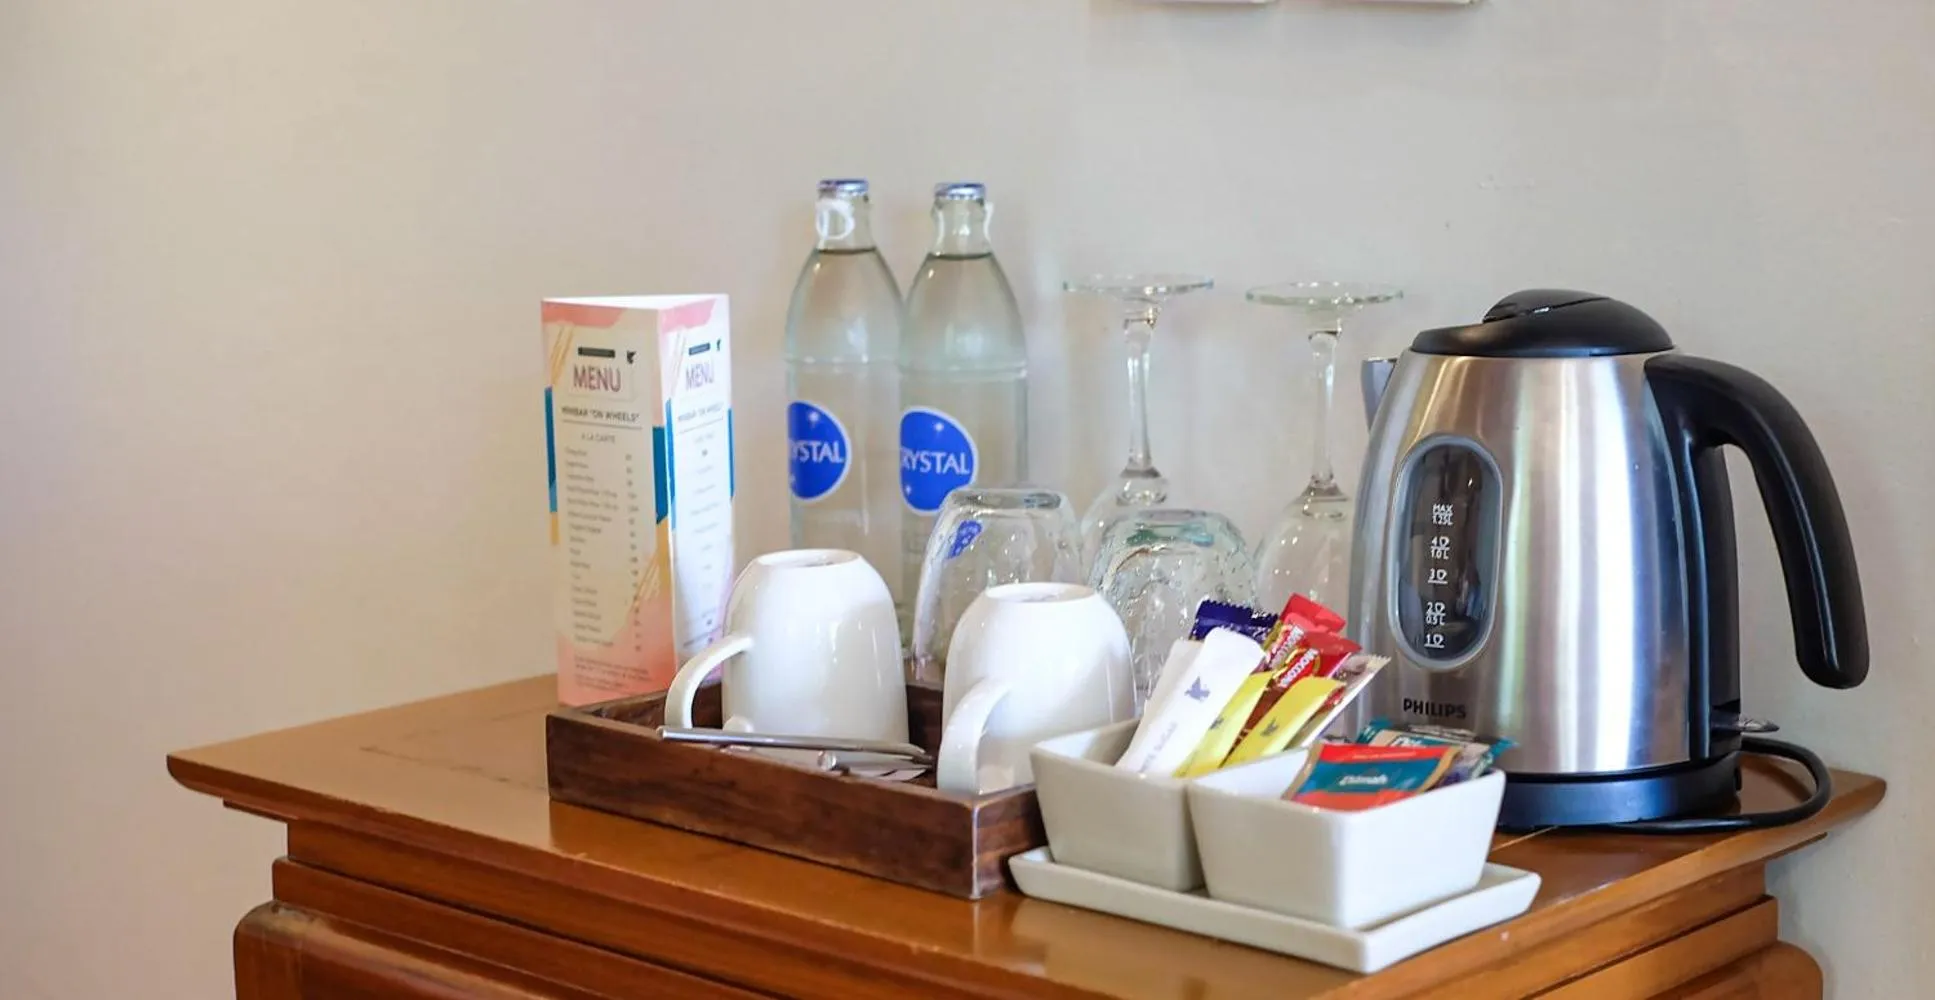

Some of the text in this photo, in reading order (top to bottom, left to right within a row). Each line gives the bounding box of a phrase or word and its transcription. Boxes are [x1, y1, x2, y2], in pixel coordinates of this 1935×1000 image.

[573, 364, 622, 393] MENU
[685, 361, 714, 391] MENU
[900, 446, 970, 475] RYSTAL
[1432, 503, 1454, 514] MAX
[1403, 698, 1467, 720] PHILIPS
